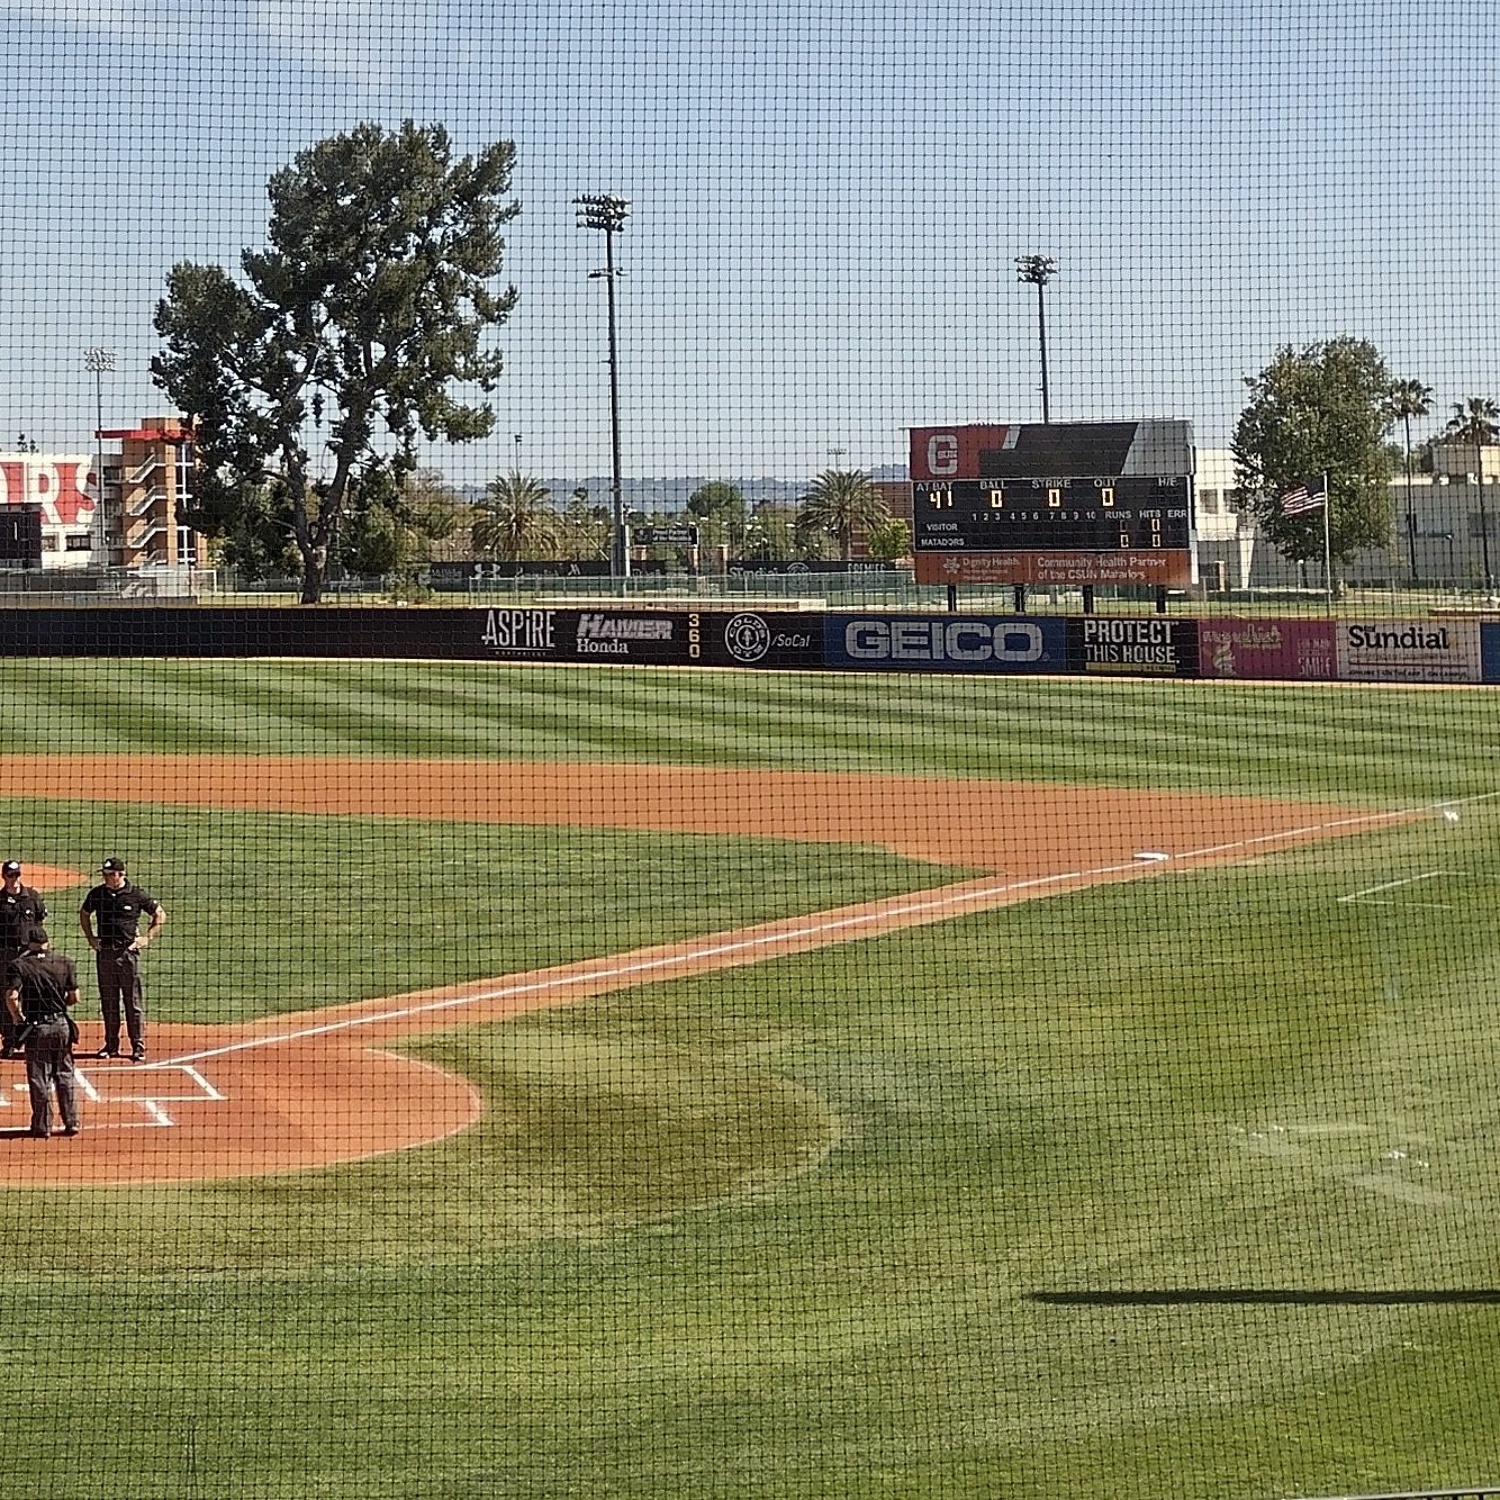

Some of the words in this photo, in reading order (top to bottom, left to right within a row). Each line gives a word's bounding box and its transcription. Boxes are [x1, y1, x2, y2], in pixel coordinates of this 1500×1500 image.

[917, 483, 929, 491] AT
[933, 482, 953, 491] BAT
[980, 481, 1008, 490] BALL
[1032, 479, 1072, 489] STRIKE
[1094, 479, 1117, 487] OUT
[930, 490, 953, 509] 41
[991, 489, 1003, 508] 0
[1048, 488, 1060, 507] 0
[1102, 488, 1114, 506] 0
[972, 513, 977, 521] 1
[983, 513, 989, 521] 2
[995, 512, 1001, 520] 3
[1010, 512, 1016, 520] 4
[1021, 512, 1027, 520] 5
[1033, 512, 1039, 520] 6
[1049, 512, 1056, 520] 7
[1061, 511, 1067, 519] 8
[1073, 511, 1079, 520] 9
[1086, 511, 1096, 519] 10
[1105, 510, 1132, 519] RUNS
[1139, 509, 1161, 518] HITS
[1168, 509, 1187, 518] ERR
[926, 523, 958, 532] VISITOR
[921, 538, 965, 547] MATADORS
[1037, 557, 1092, 570] Community
[1096, 555, 1127, 567] Health
[1129, 557, 1166, 567] Partner
[1037, 569, 1048, 580] of
[1067, 569, 1098, 580] CSUN
[577, 614, 673, 639] HAMER
[688, 613, 700, 658] 360
[1084, 620, 1171, 643] PROTECT
[577, 639, 628, 653] Honda
[846, 621, 1043, 662] GEICO
[1348, 625, 1450, 649] Sundial
[1084, 644, 1119, 662] THIS
[1122, 645, 1180, 663] HOUSE.
[1298, 657, 1331, 677] SMILE
